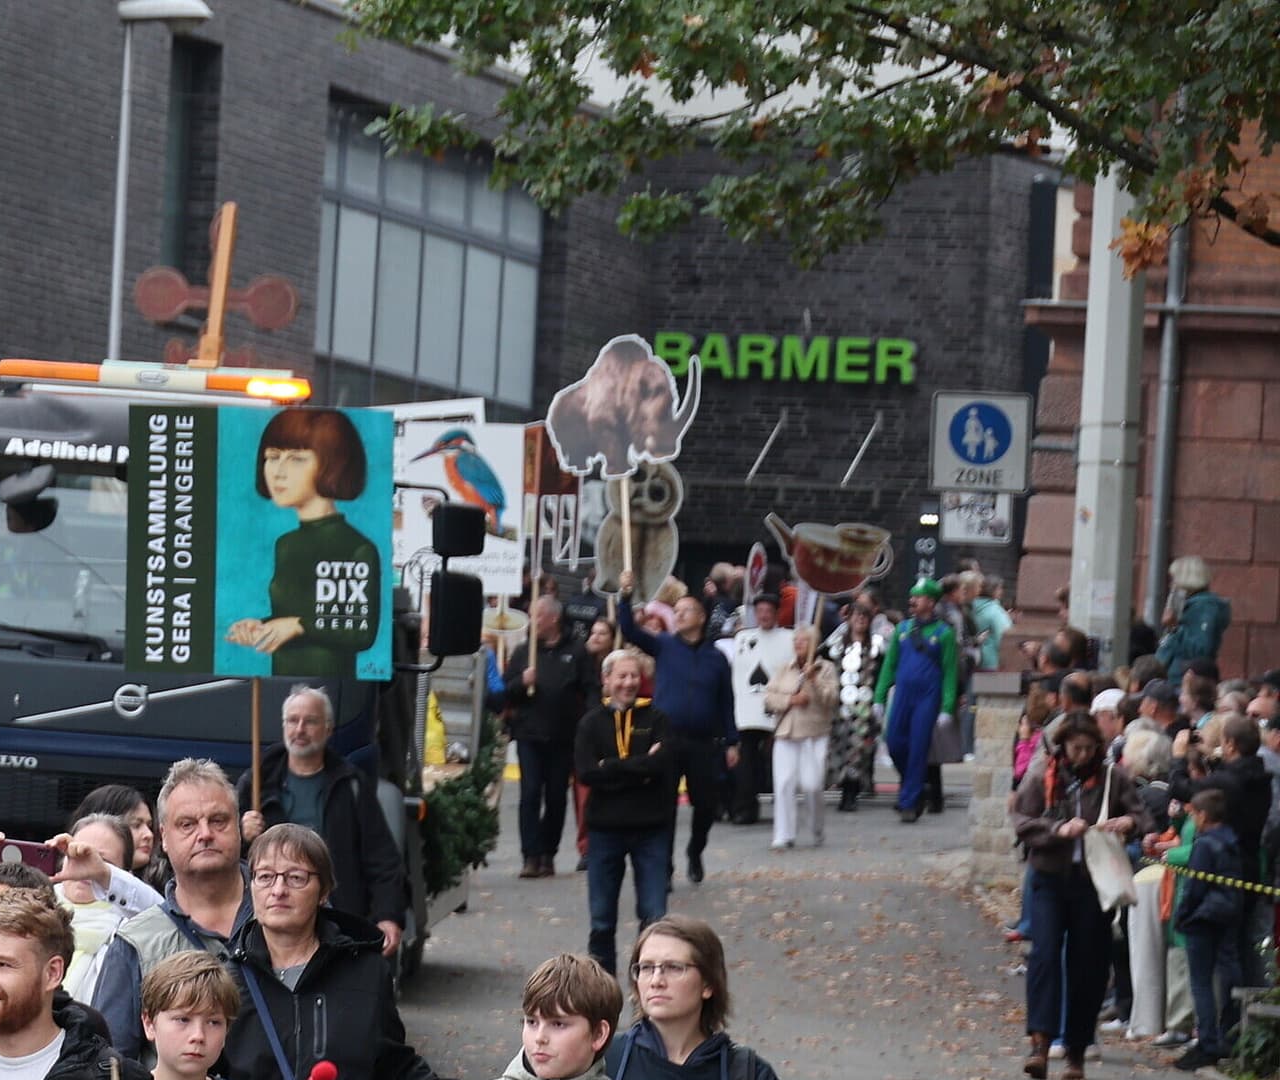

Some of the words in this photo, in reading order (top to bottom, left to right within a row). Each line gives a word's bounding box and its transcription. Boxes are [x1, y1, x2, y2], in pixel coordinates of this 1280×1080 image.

[654, 332, 917, 385] BARMER
[4, 437, 113, 463] Adelheid
[954, 468, 1005, 486] ZONE
[173, 415, 195, 569] ORANGERIE
[145, 414, 169, 663] KUNSTSAMMLUNG
[315, 560, 370, 579] OTTO
[315, 578, 369, 604] DIX
[315, 603, 369, 616] HAUS
[171, 592, 192, 663] GERA
[315, 617, 369, 631] GERA
